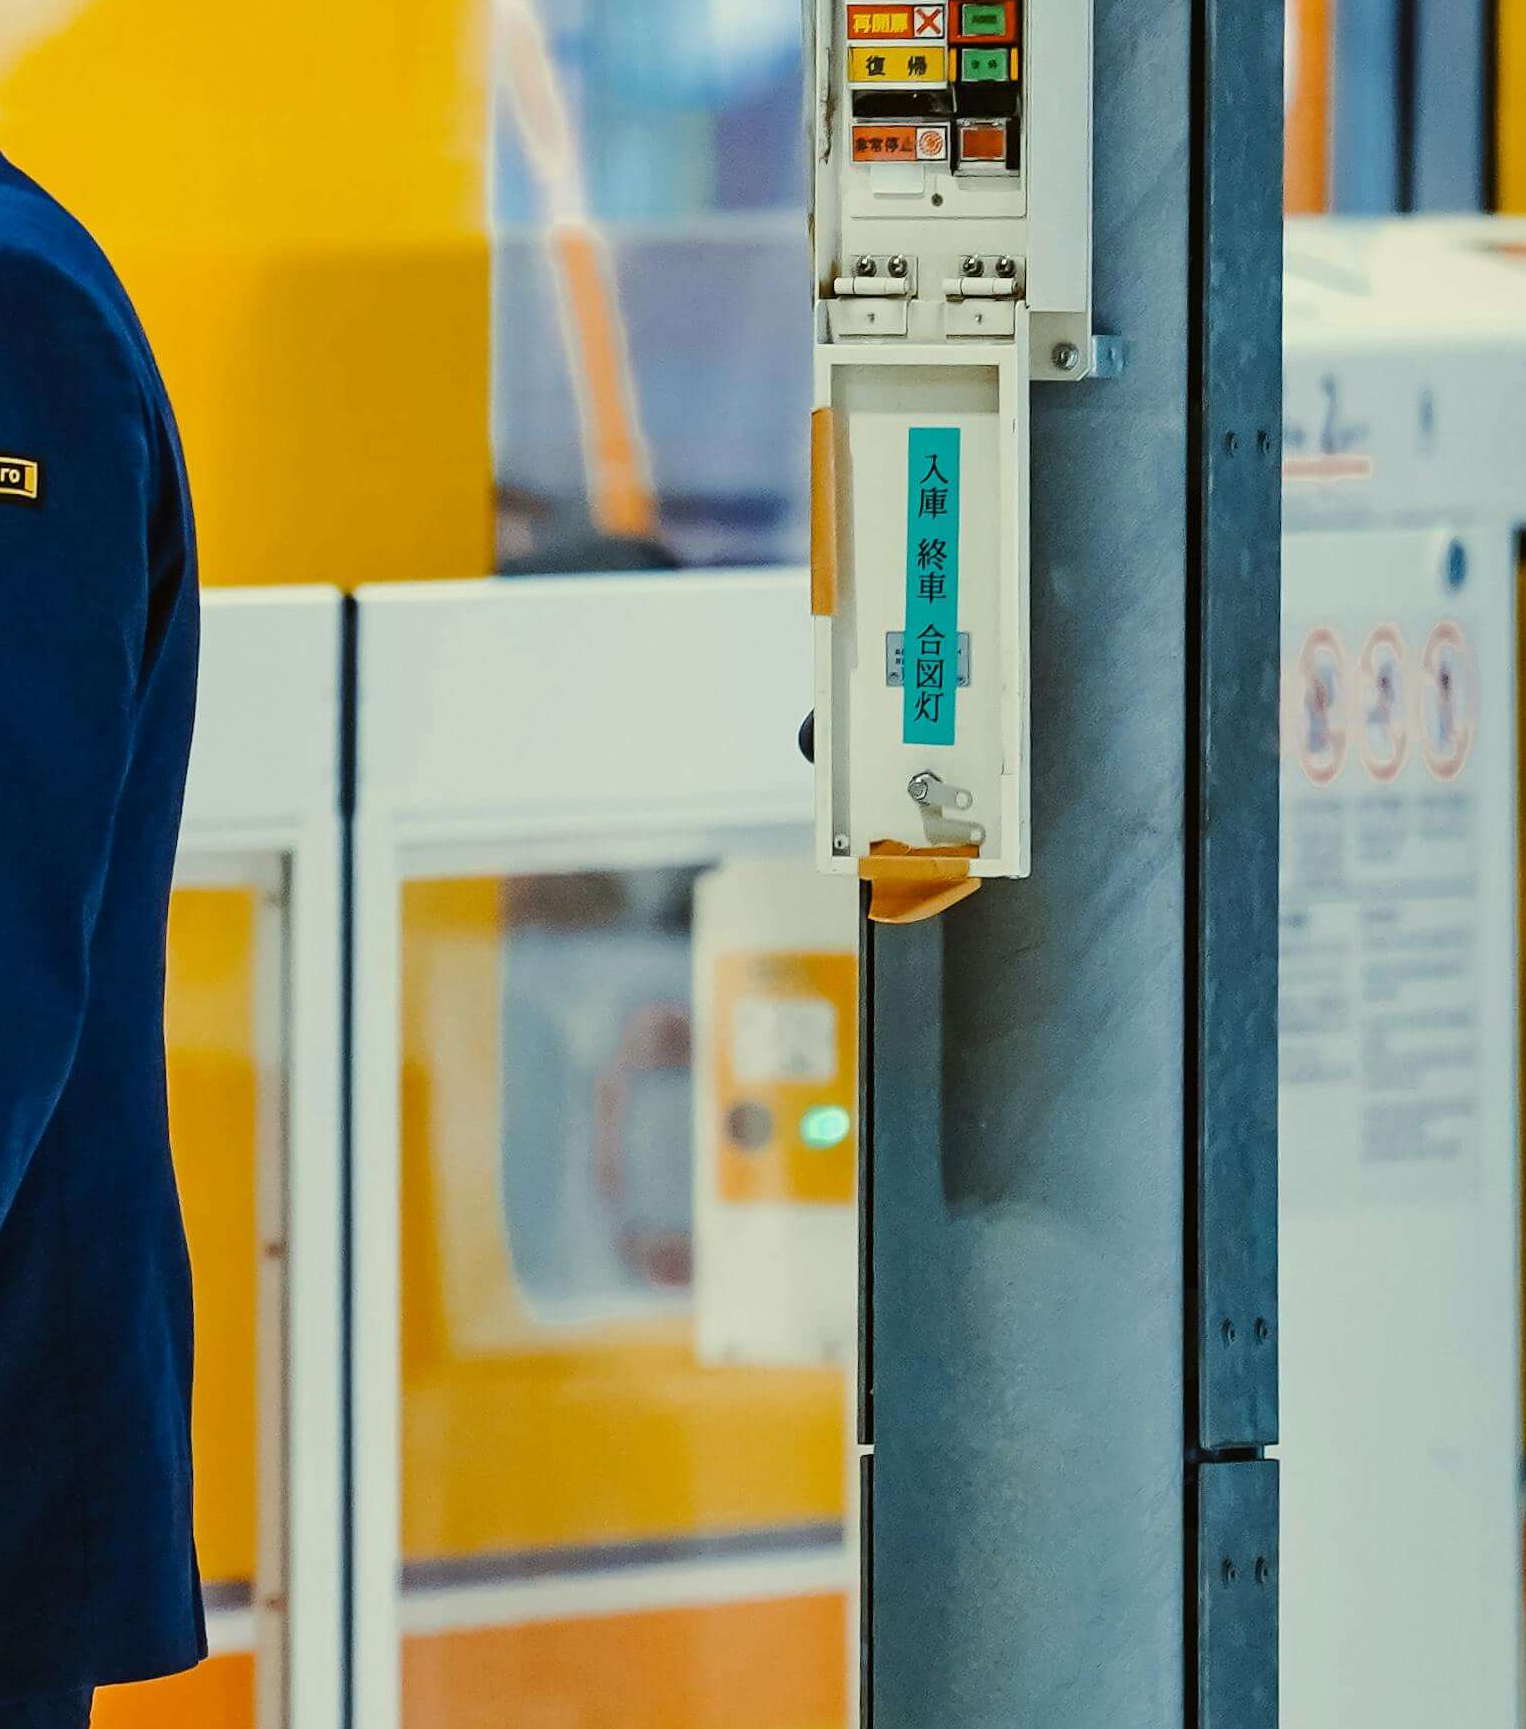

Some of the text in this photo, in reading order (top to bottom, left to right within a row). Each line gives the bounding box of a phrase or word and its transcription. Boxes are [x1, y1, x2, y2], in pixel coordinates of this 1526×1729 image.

[914, 453, 949, 724] 入庫 終車 合図灯
